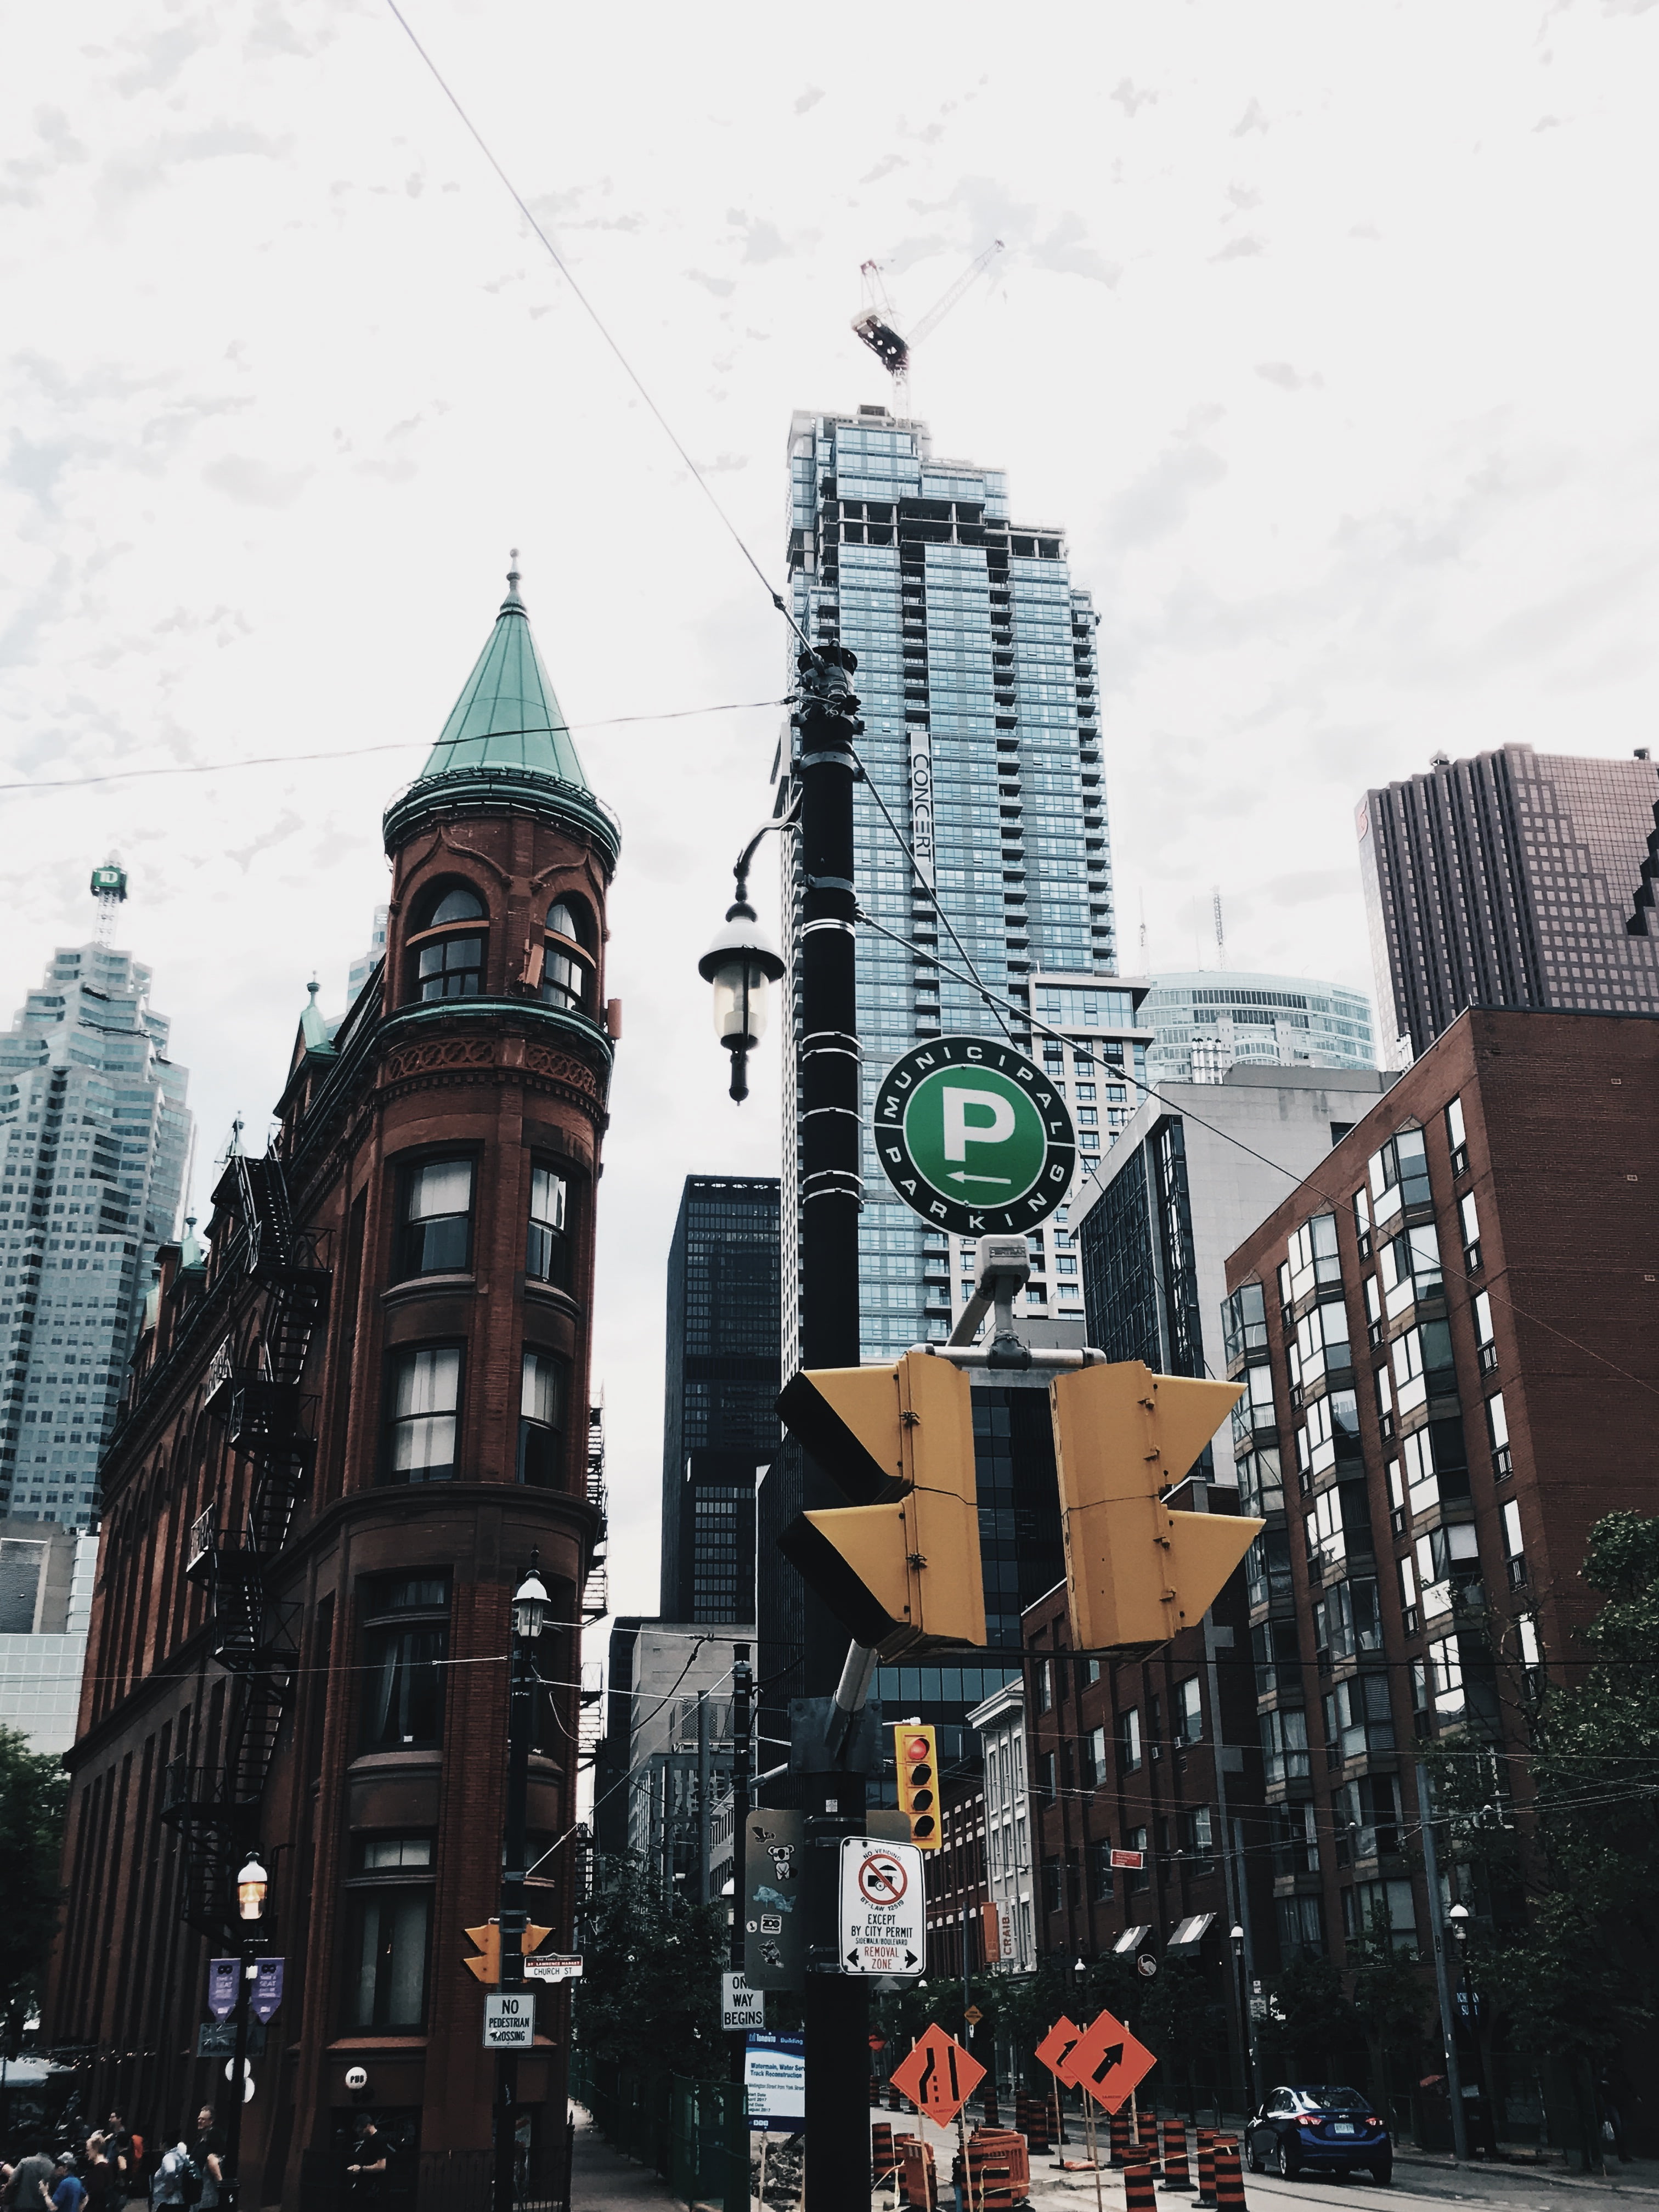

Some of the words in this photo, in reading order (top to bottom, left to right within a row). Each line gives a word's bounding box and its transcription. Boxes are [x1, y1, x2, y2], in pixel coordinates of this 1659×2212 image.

[913, 754, 931, 862] CONCERT
[98, 871, 118, 883] TD
[883, 1046, 1063, 1134] MUNICIPAL
[943, 1086, 1015, 1162] P
[885, 1147, 1065, 1230] PARKING
[863, 1851, 873, 1860] NO
[874, 1848, 901, 1861] VENDING
[860, 1897, 885, 1911] BY-LAW
[888, 1899, 905, 1911] 12519
[868, 1914, 895, 1925] EXCEPT
[851, 1926, 861, 1936] BY
[865, 1926, 882, 1937] CITY
[886, 1927, 913, 1938] PERMIT
[1002, 1916, 1012, 1955] CRAIB
[856, 1937, 908, 1945] SIDEWALK/BOULEVARD
[865, 1946, 899, 1957] REMOVAL
[872, 1959, 892, 1970] ZONE
[732, 1976, 748, 1989] ON
[501, 1999, 519, 2015] NO
[732, 1994, 754, 2007] WAY
[489, 2017, 529, 2028] PEDESTRIAN
[724, 2011, 763, 2025] BEGINS
[780, 2037, 803, 2045] Building
[350, 2075, 364, 2084] PUB
